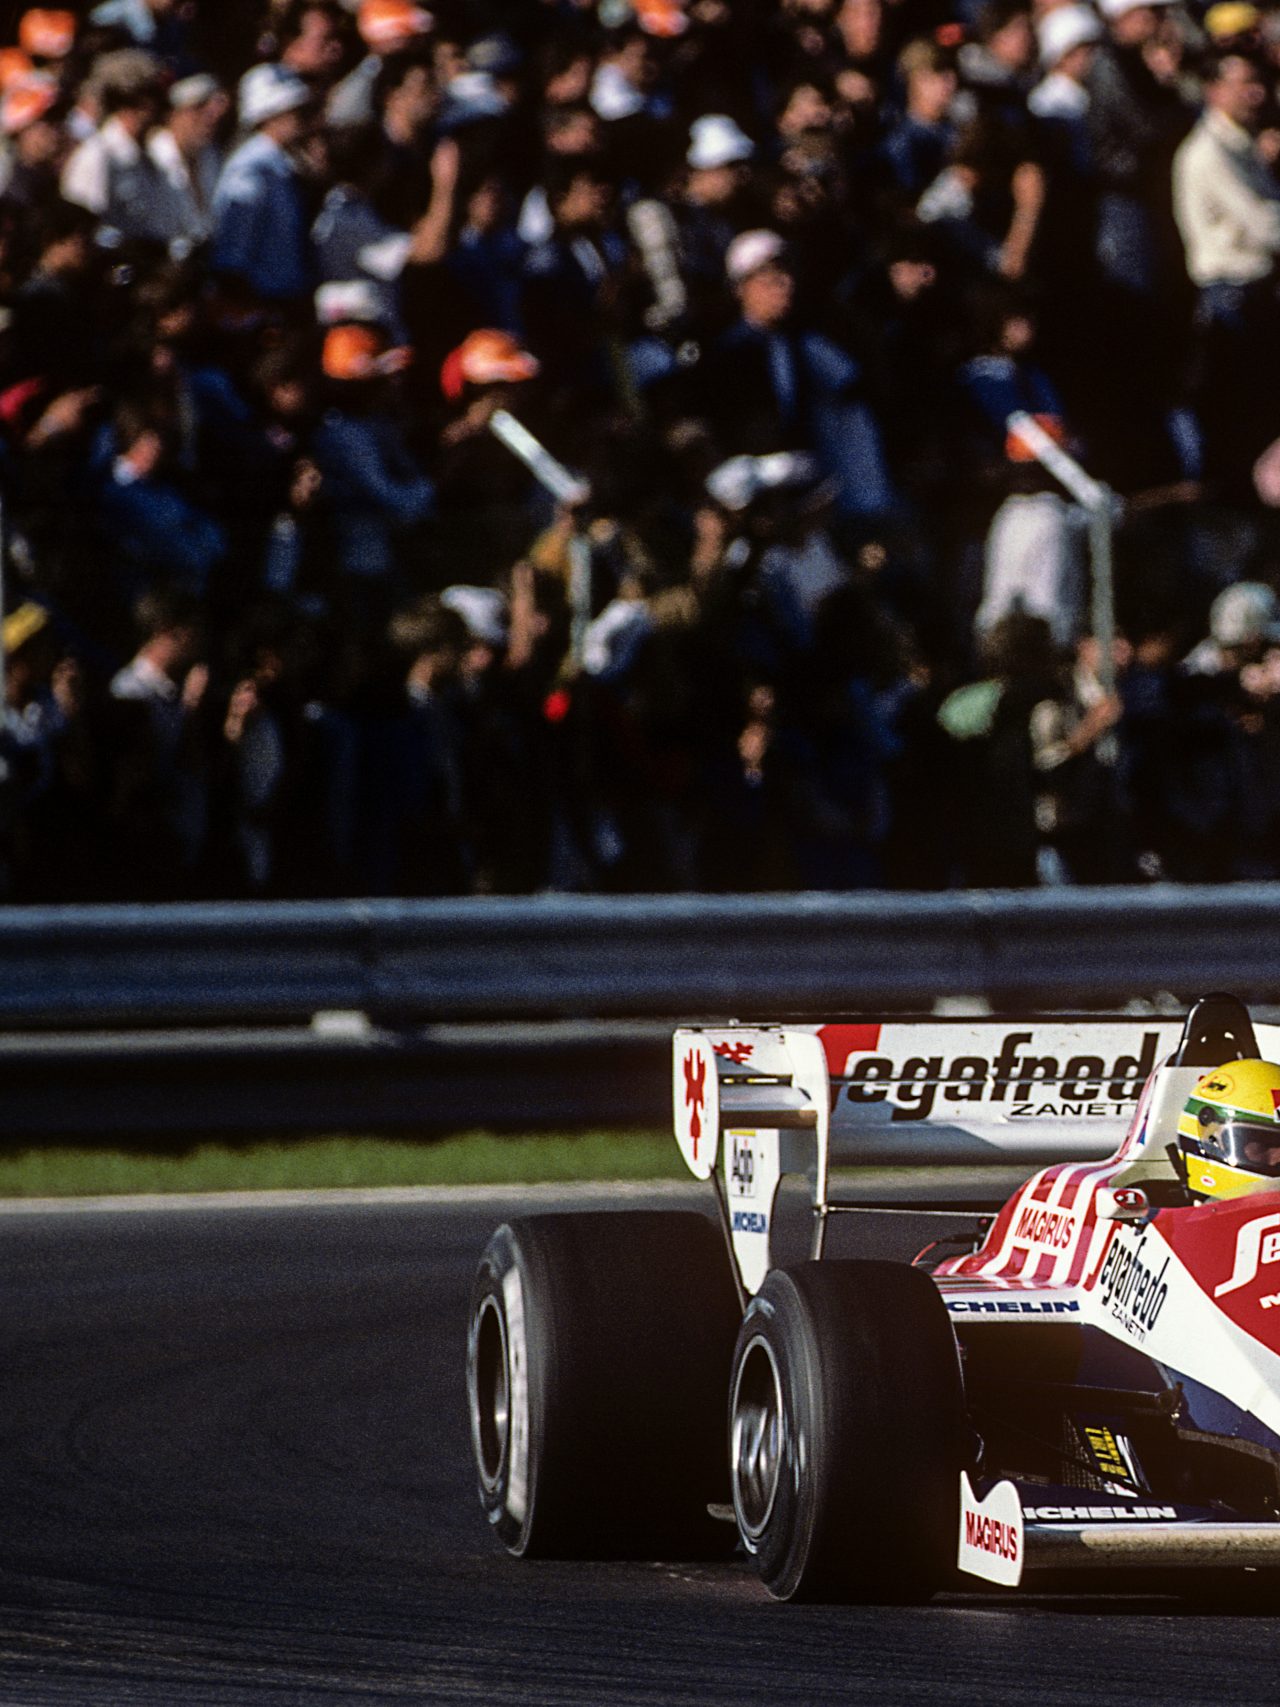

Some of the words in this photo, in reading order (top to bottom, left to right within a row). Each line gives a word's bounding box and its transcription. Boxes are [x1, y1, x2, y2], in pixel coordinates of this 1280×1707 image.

[1015, 1207, 1075, 1249] MAGIRUS
[945, 1301, 1080, 1313] CHELIN
[1111, 1302, 1145, 1343] ZANETTI
[1021, 1507, 1177, 1519] ICHELIN
[965, 1511, 1018, 1562] MAGIRUS
